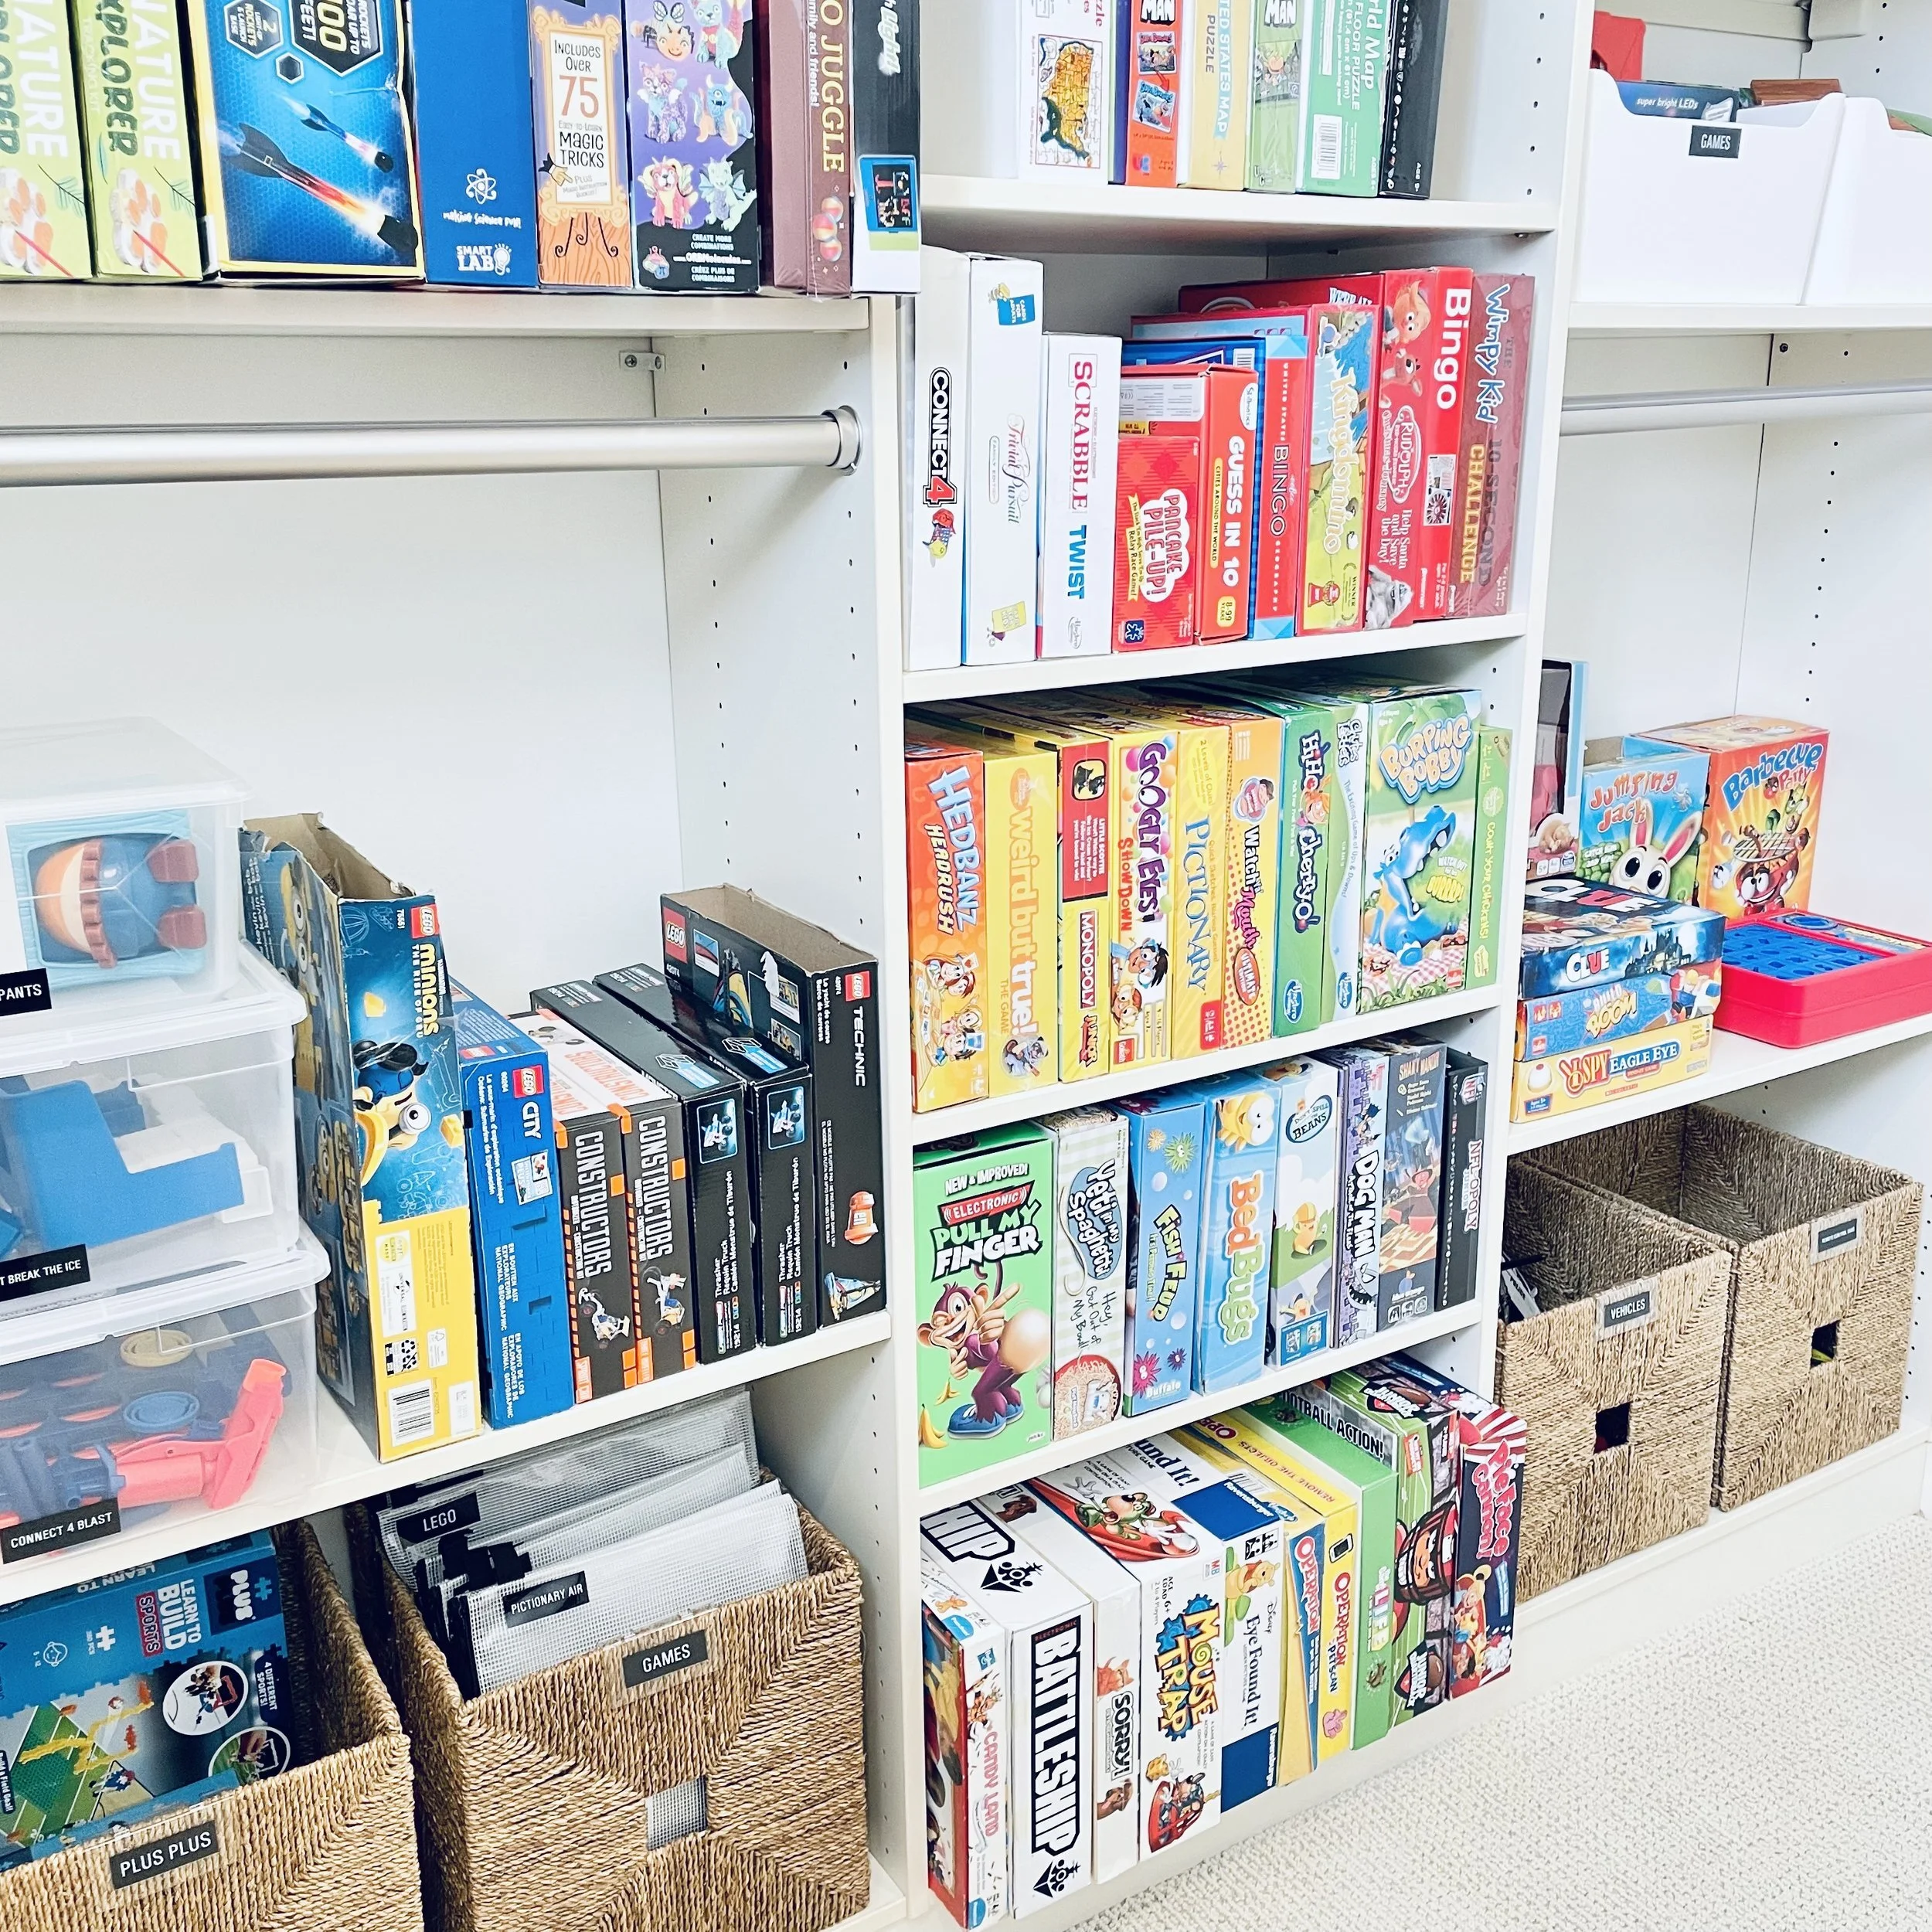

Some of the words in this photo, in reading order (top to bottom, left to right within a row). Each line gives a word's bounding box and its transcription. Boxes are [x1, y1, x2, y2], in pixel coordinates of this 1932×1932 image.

[349, 39, 360, 55] TO
[809, 31, 818, 55] and
[1206, 15, 1216, 73] PUZZLE
[1352, 2, 1363, 52] FLOOR
[1219, 33, 1231, 93] STATES
[1352, 56, 1361, 111] PUZZLE
[1361, 36, 1380, 90] Map
[559, 75, 599, 118] 75
[821, 35, 845, 172] JUGGLE
[1217, 100, 1232, 133] MAP
[1637, 97, 1657, 107] super
[1658, 97, 1678, 109] bright
[1679, 98, 1699, 110] LEDs
[560, 150, 604, 168] TRICKS
[1701, 134, 1731, 151] GAMES
[456, 245, 493, 256] SMART
[457, 255, 494, 272] LAB
[1434, 288, 1471, 410] Bingo
[1475, 284, 1509, 375] Wimpy
[1475, 379, 1505, 423] Kid
[932, 372, 948, 478] CONNECT
[1072, 361, 1093, 511] SCRABBLE
[927, 476, 954, 503] 4
[1226, 436, 1245, 515] GUESS
[1270, 445, 1288, 536] BINGO
[1164, 495, 1182, 573] PANCAKE
[1225, 522, 1240, 546] IN
[1402, 510, 1413, 535] Help
[1460, 444, 1485, 583] CHALLENGE
[1069, 525, 1087, 599] TWIST
[1144, 507, 1166, 595] PILE-UP!
[1223, 556, 1240, 587] 10
[1389, 538, 1400, 566] Save
[1399, 537, 1410, 569] Santa
[1381, 716, 1471, 780] BURPING
[1398, 746, 1462, 797] BOBBY
[1589, 770, 1678, 810] Jumping
[1723, 743, 1824, 810] Barbecue
[1777, 767, 1814, 791] Party
[1138, 743, 1167, 853] GOOGLY
[1598, 801, 1647, 832] Jack
[927, 765, 980, 932] HEDBANZ
[1244, 825, 1260, 888] Watch
[1485, 821, 1495, 854] COUNT
[1138, 859, 1165, 914] EYES
[1482, 857, 1494, 883] YOUR
[420, 907, 434, 936] LEGO
[1183, 815, 1211, 991] PICTIONARY
[1479, 886, 1493, 938] CHICKENS!
[411, 944, 420, 967] THE
[667, 923, 685, 947] LEGO
[1080, 913, 1095, 1007] MONOPOLY
[1242, 952, 1257, 998] ULTIMATE
[1566, 948, 1610, 982] CLUE
[852, 975, 863, 998] LEGO
[1000, 1002, 1009, 1034] GAME
[1586, 992, 1637, 1039] BOOM
[853, 1005, 866, 1087] TECHNIC
[1583, 1052, 1609, 1083] SPY
[1610, 1050, 1651, 1073] EAGLE
[1652, 1044, 1678, 1062] EYE
[522, 1068, 537, 1096] LEGO
[520, 1102, 541, 1141] CITY
[1292, 1112, 1328, 1140] BEANS
[638, 1115, 673, 1260] CONSTRUCTORS
[725, 1170, 734, 1205] Tiburón
[791, 1157, 800, 1191] Tiburón
[944, 1177, 967, 1196] NEW
[977, 1163, 1029, 1184] IMPROVED!
[1354, 1150, 1379, 1208] DOG
[575, 1130, 612, 1277] CONSTRUCTORS
[953, 1191, 1019, 1219] ELECTRONIC
[1087, 1159, 1117, 1216] Yeti
[1107, 1223, 1119, 1243] My
[1227, 1173, 1262, 1256] Bed
[728, 1217, 736, 1260] Monstruo
[933, 1218, 994, 1249] PULL
[999, 1199, 1042, 1233] MY
[1069, 1192, 1114, 1277] Spaghetti
[1154, 1205, 1182, 1257] FISH
[1354, 1208, 1376, 1258] MAN
[8, 1269, 40, 1284] BREAK
[43, 1264, 63, 1276] THE
[65, 1259, 81, 1270] ICE
[495, 1247, 504, 1284] NATIONAL
[502, 1244, 512, 1301] EXPLORATEURS
[509, 1254, 517, 1287] SOUTIEN
[934, 1226, 1042, 1279] FINGER
[498, 1286, 507, 1332] GEOGRAPHIC
[1070, 1300, 1084, 1321] My
[1086, 1286, 1098, 1308] Get
[1153, 1260, 1187, 1321] FEUD
[1221, 1244, 1263, 1342] Bugs
[1611, 1298, 1646, 1321] VEHICLES
[1090, 1311, 1100, 1331] Out
[502, 1336, 511, 1372] NATIONAL
[509, 1335, 519, 1391] EXPLORADORES
[1336, 1417, 1384, 1459] ACTION!
[1138, 1455, 1157, 1470] GAME
[1167, 1468, 1200, 1487] It!
[1488, 1440, 1512, 1490] Pie
[1224, 1481, 1274, 1517] Ravensburger
[1298, 1478, 1336, 1503] REMOVE
[1472, 1463, 1495, 1560] Cannon!
[10, 1526, 63, 1549] CONNECT
[66, 1522, 75, 1533] 4
[77, 1512, 114, 1530] BLAST
[423, 1509, 457, 1532] LEGO
[1493, 1487, 1516, 1558] Face
[1211, 1560, 1220, 1577] MB
[1294, 1536, 1320, 1634] OPERATION
[157, 1583, 187, 1651] BUILD
[180, 1579, 197, 1622] LEARN
[231, 1570, 254, 1620] PLUS
[510, 1589, 566, 1616] PICTIONARY
[567, 1583, 583, 1600] AIR
[138, 1595, 161, 1653] SPORTS
[186, 1624, 202, 1644] TO
[1035, 1620, 1078, 1641] ELECTRONIC
[1243, 1614, 1260, 1645] Eye
[1335, 1572, 1352, 1666] OPERATION
[642, 1644, 692, 1675] GAMES
[1183, 1603, 1219, 1725] MOUSE
[1247, 1645, 1264, 1705] Found
[256, 1672, 268, 1707] SPORTS!
[264, 1668, 277, 1710] DIFFERENT
[1155, 1634, 1190, 1732] TRAP
[1035, 1627, 1077, 1852] BATTLESHIP
[1114, 1693, 1131, 1777] SORRY!
[1242, 1706, 1259, 1730] It!
[983, 1731, 998, 1788] CANDY
[1266, 1727, 1277, 1787] Ravensburger
[985, 1792, 999, 1837] LAND
[120, 1849, 165, 1879] PLUS
[168, 1831, 213, 1861] PLUS
